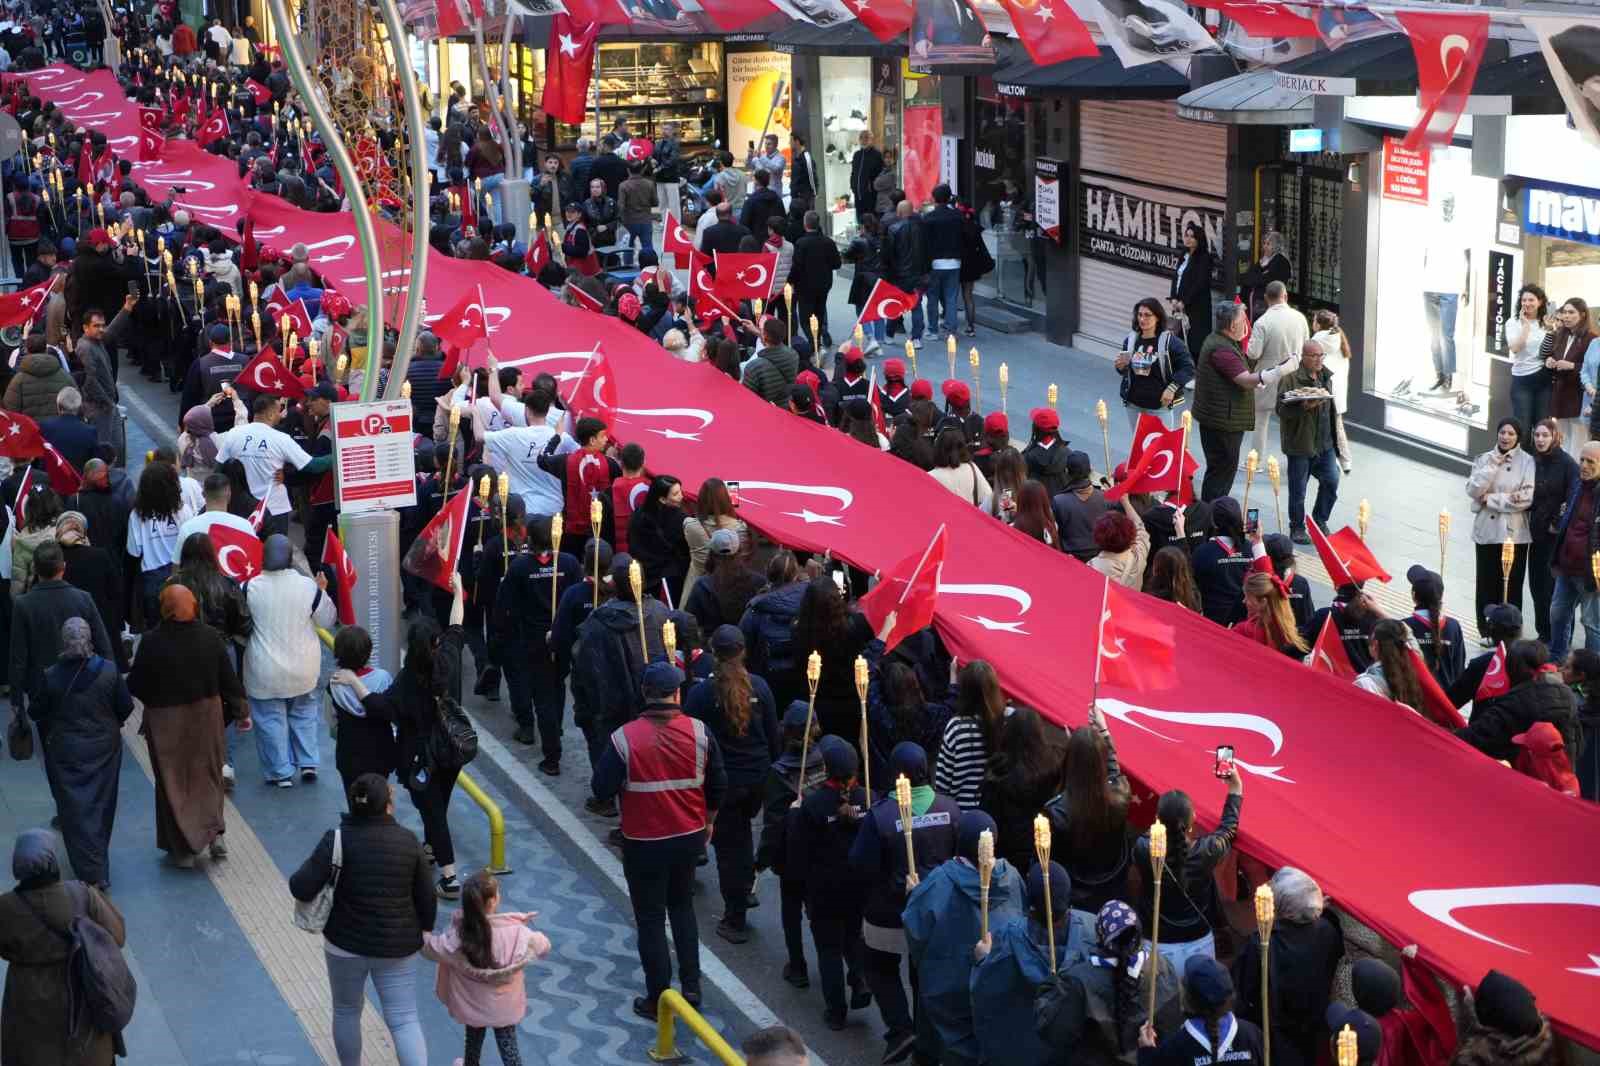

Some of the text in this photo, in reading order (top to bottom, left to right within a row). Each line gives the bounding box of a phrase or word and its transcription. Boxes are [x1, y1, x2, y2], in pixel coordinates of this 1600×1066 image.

[1086, 187, 1223, 260] HAMILTON
[1090, 237, 1116, 254] ÇANTA
[1119, 241, 1152, 264] CÜZDAN
[1496, 258, 1505, 294] JACK
[1495, 306, 1504, 351] JONES
